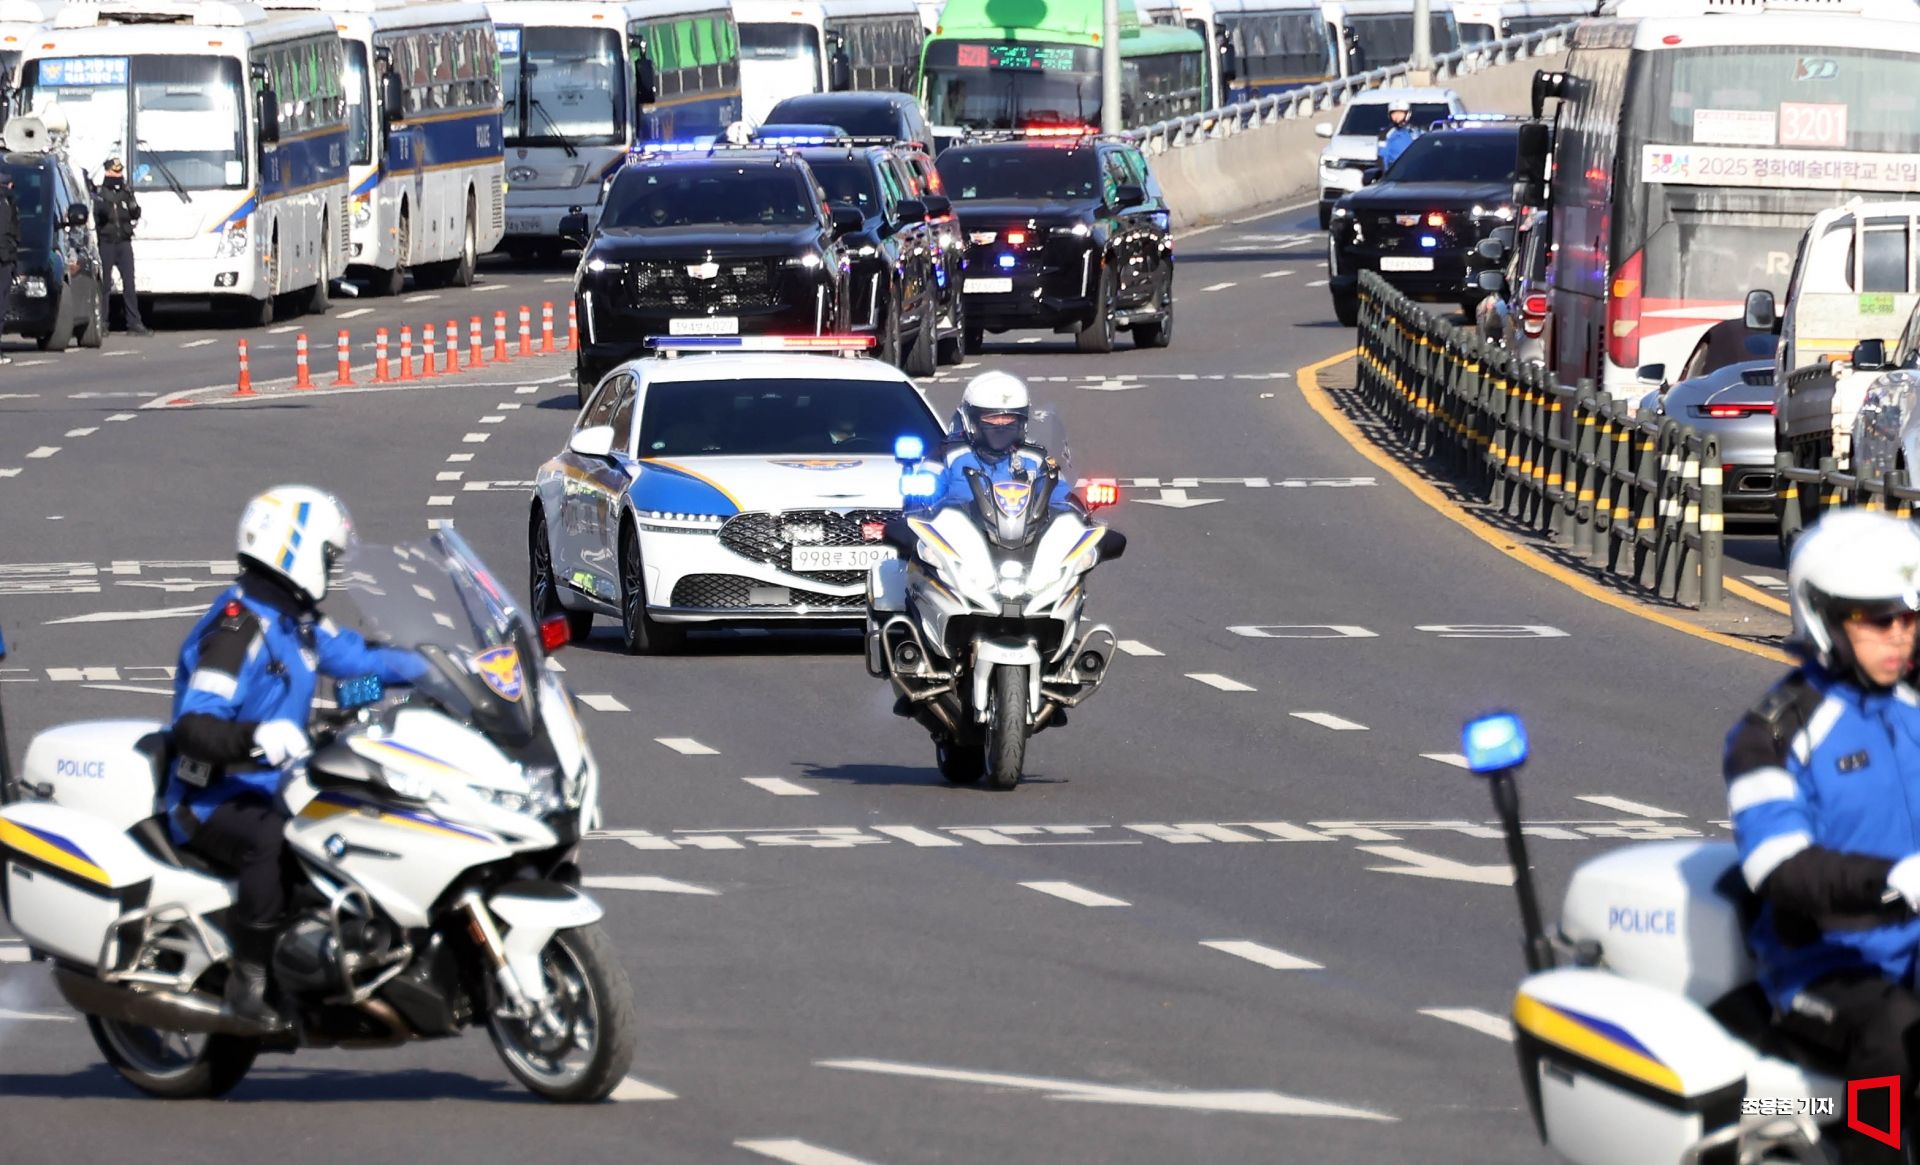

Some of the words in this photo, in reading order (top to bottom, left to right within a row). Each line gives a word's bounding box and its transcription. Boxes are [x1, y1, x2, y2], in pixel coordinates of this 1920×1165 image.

[1785, 106, 1845, 143] 3201
[1699, 157, 1748, 176] 2025
[1752, 158, 1878, 181] 정화예술대학교
[1884, 162, 1917, 182] 신입
[57, 759, 105, 779] POLICE
[1608, 907, 1677, 935] POLICE
